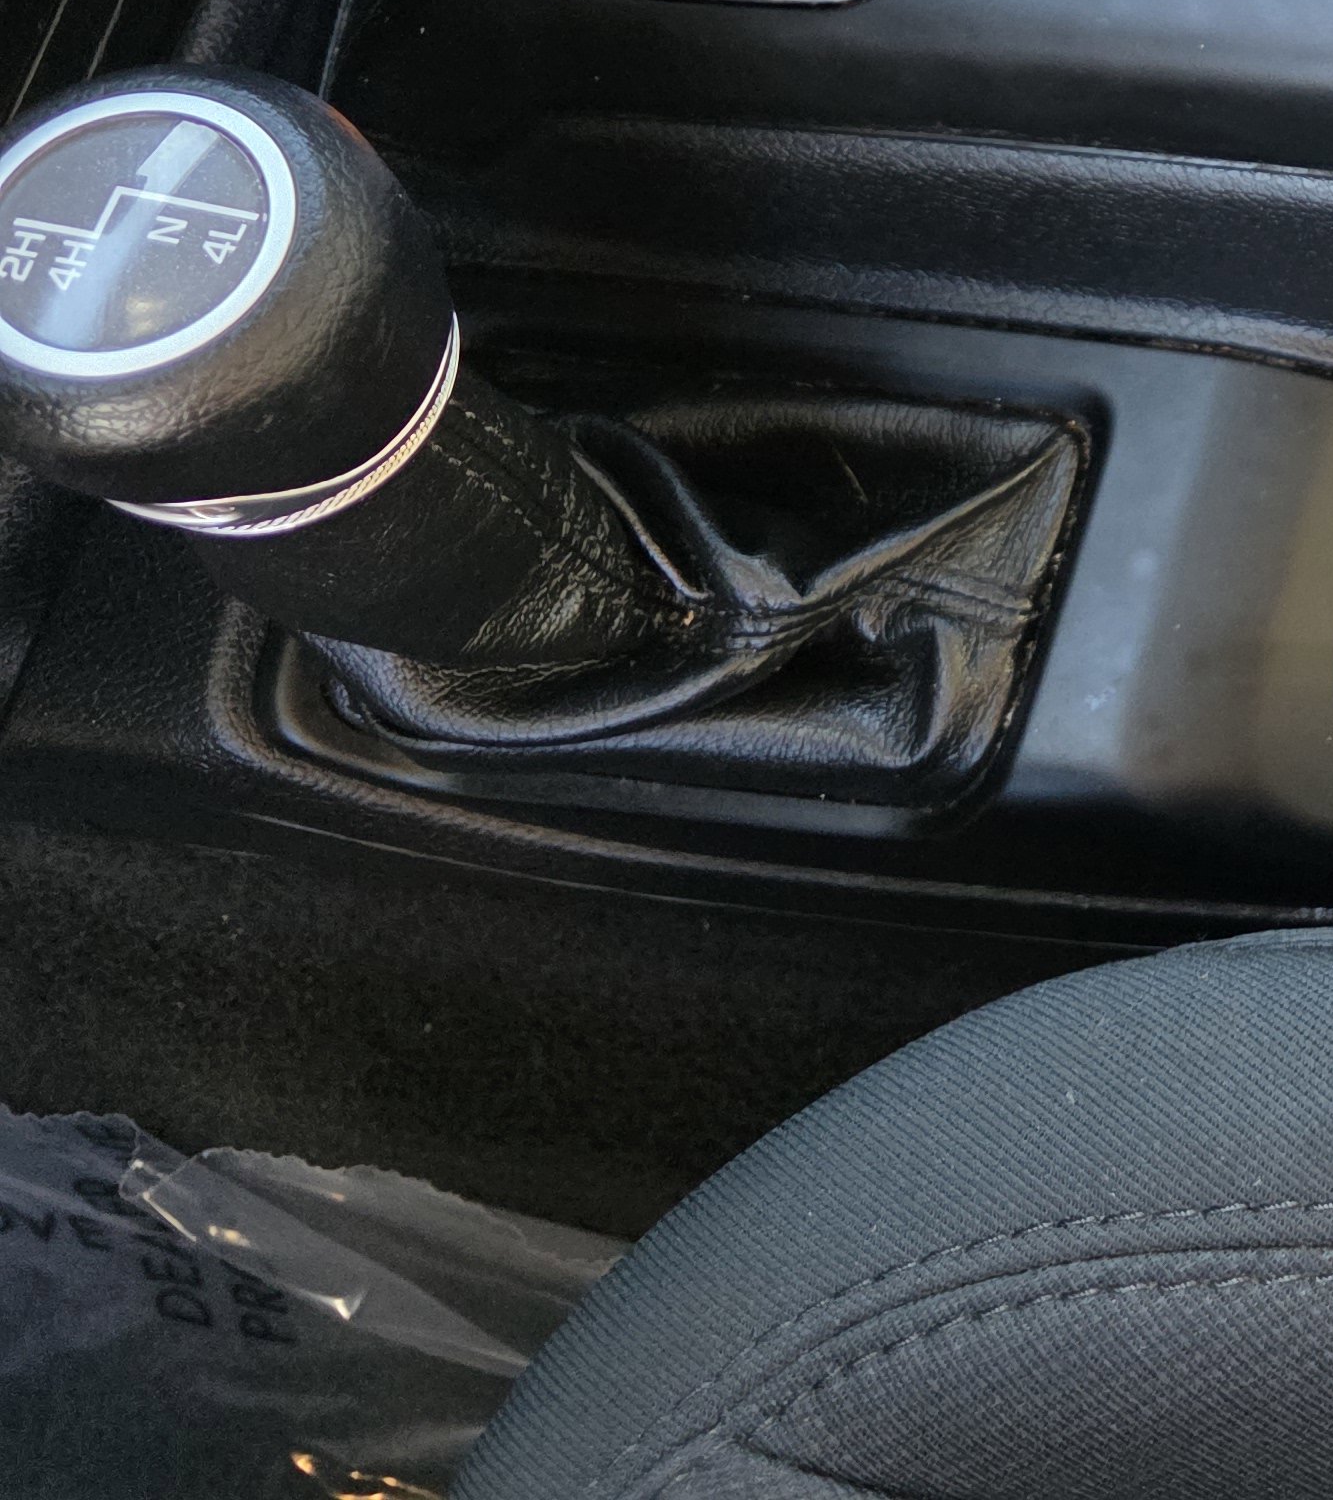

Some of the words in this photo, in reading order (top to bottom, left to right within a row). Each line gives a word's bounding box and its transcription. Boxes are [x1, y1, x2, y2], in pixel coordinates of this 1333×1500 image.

[147, 216, 188, 245] N
[202, 223, 247, 265] 4L
[0, 231, 46, 282] 2H
[48, 240, 96, 291] 4H
